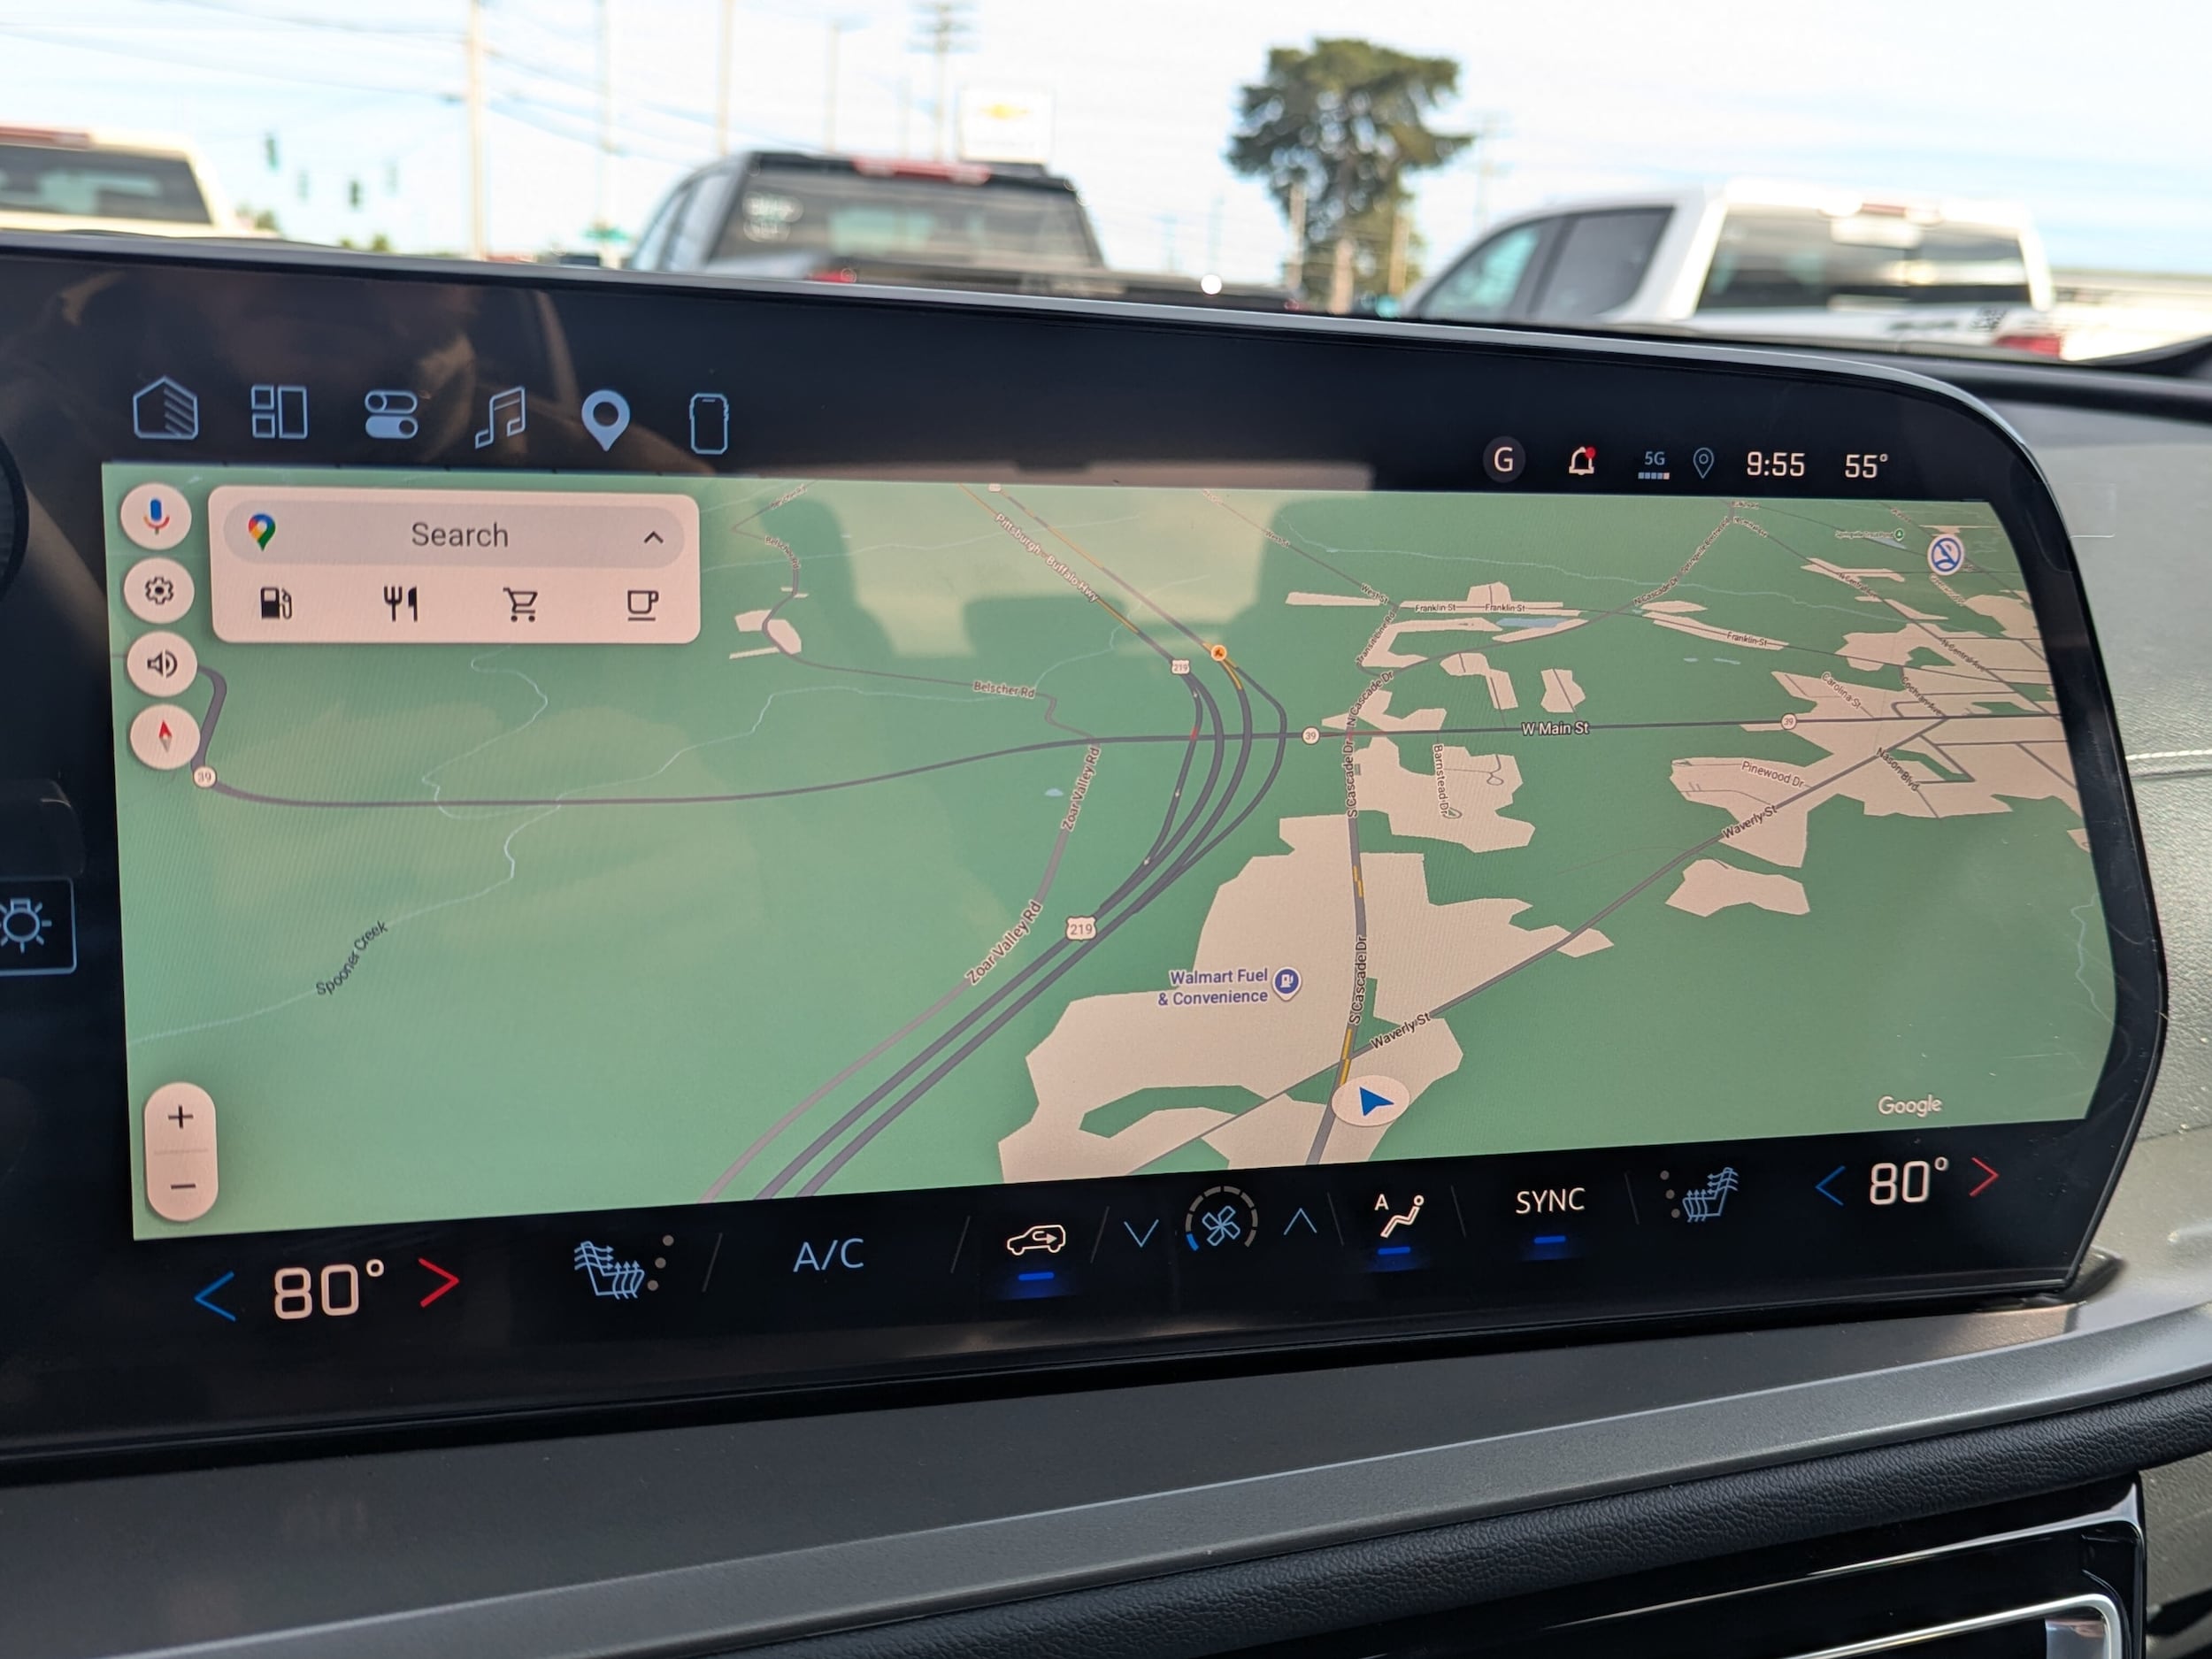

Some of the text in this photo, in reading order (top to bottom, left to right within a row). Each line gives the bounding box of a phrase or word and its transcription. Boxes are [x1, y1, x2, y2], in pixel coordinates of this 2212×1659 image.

[1494, 446, 1515, 472] G
[1644, 450, 1666, 466] 5G
[1746, 450, 1806, 478] 9:55
[1844, 452, 1889, 480] 55°
[411, 520, 510, 548] Search
[996, 513, 1041, 555] Pittsburgh
[1046, 555, 1079, 586] Buffalo
[1077, 581, 1099, 603] Hwy
[1361, 583, 1388, 604] West St
[1640, 584, 1671, 603] Cascade
[1669, 577, 1678, 588] Dr
[1844, 575, 1870, 593] Central
[1415, 603, 1456, 612] Franklin St
[1485, 603, 1525, 613] Franklin St
[1356, 611, 1396, 664] Transit Line Rd
[1726, 631, 1768, 648] Franklin St
[1947, 643, 1974, 664] Central
[973, 680, 1035, 698] Belscher Rd
[1347, 670, 1394, 726] N Cascade Dr
[1821, 672, 1861, 709] Carolina St
[1902, 675, 1930, 706] Cochran
[1521, 721, 1590, 736] W Main St
[1342, 741, 1357, 818] S Cascade Dr
[1433, 743, 1449, 815] Barnstead Dr
[1741, 760, 1805, 788] Pinewood Dr
[1877, 747, 1920, 792] Nason Blvd
[1062, 747, 1100, 831] Zoar Valley Rd
[1722, 804, 1778, 839] Waverly St
[965, 900, 1042, 984] Zoar Valley Rd
[1069, 923, 1094, 935] 219
[315, 919, 388, 995] Spooner Creek
[1170, 968, 1268, 986] Walmart Fuel
[1349, 935, 1367, 1025] S Cascade Dr
[1157, 989, 1268, 1006] & Convenience
[1371, 1011, 1432, 1050] Waverly St
[1877, 1094, 1943, 1118] Google
[1869, 1156, 1948, 1206] 80°
[1374, 1194, 1389, 1211] A
[1515, 1187, 1586, 1215] SYNC
[792, 1238, 864, 1273] A/C
[273, 1257, 385, 1320] 80°
